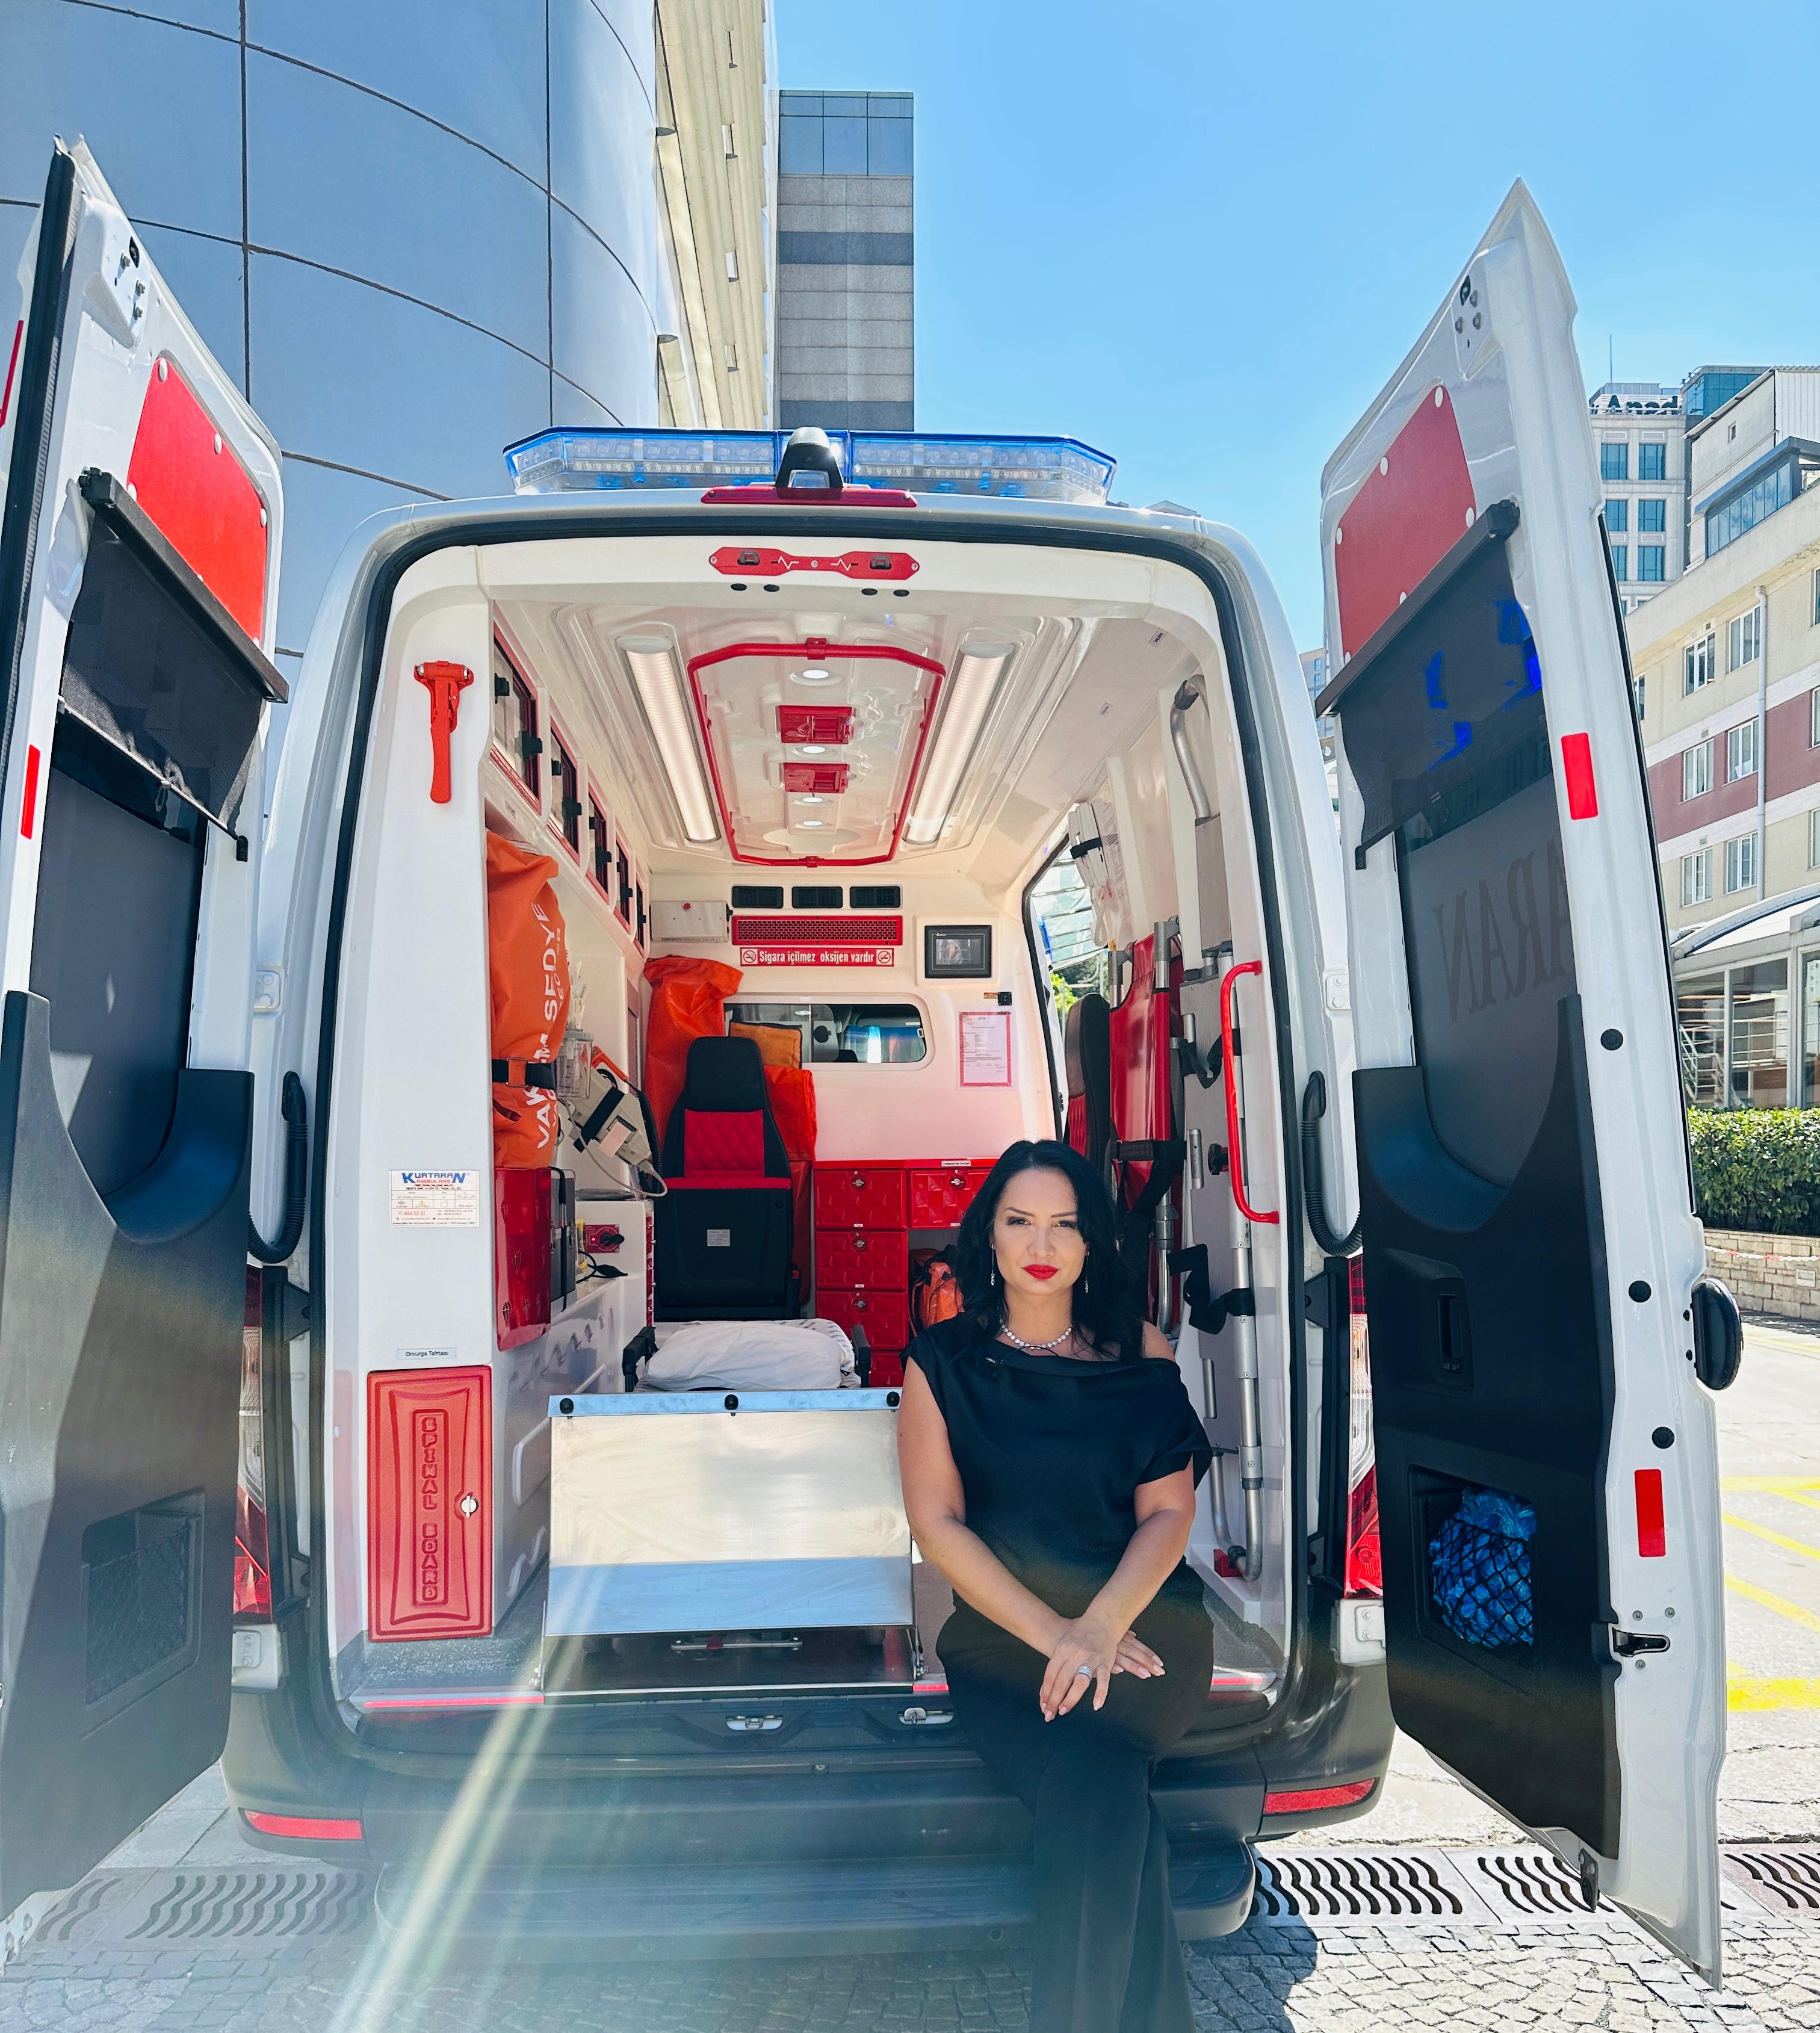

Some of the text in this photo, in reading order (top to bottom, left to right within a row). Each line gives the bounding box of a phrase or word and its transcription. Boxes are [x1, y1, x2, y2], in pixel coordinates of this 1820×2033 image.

[1606, 395, 1682, 415] Anad
[760, 951, 874, 965] Sigara içilmez oksijen vardır
[522, 902, 559, 1149] VAKM SEDYE
[401, 1172, 466, 1184] KURTARAN
[421, 1417, 438, 1601] SPINAL BOARD
